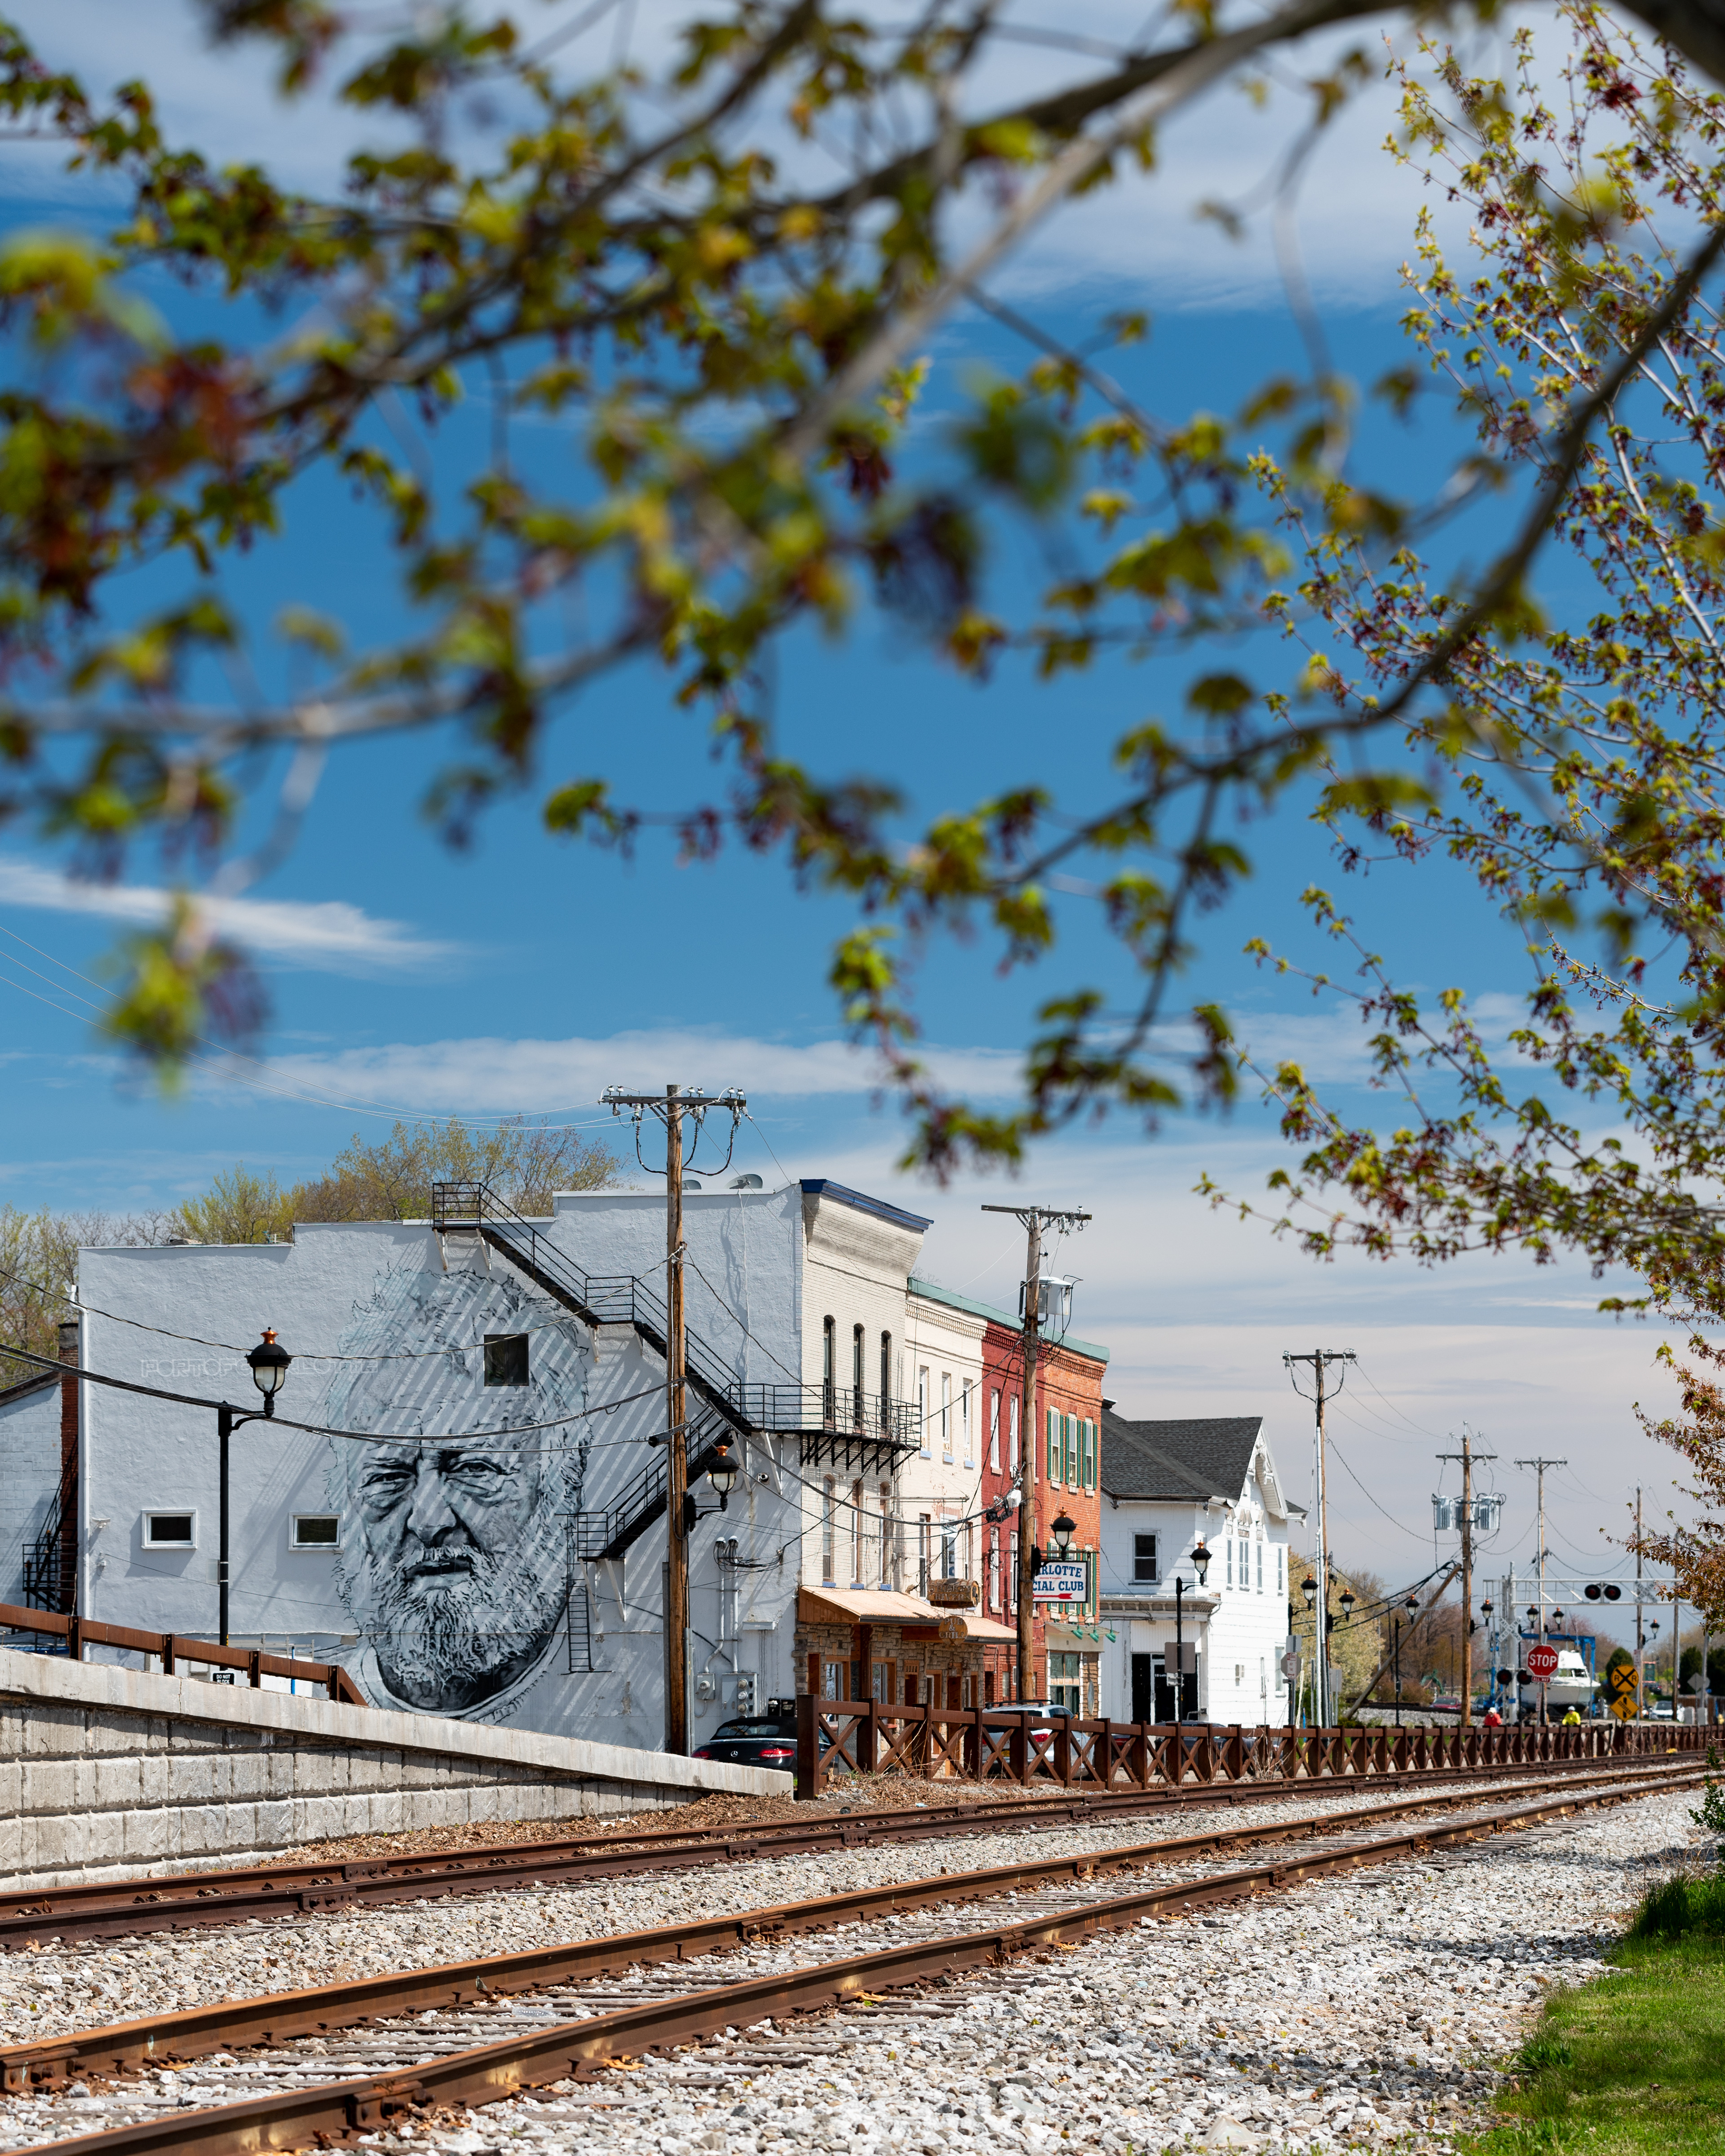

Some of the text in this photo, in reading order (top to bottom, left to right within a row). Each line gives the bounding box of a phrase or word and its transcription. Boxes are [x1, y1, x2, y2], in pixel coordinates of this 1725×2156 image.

[235, 1357, 378, 1377] CRLOTTE
[1038, 1564, 1082, 1577] RLOTTE
[1033, 1581, 1084, 1591] CIAL CLUB
[1529, 1654, 1557, 1667] STOP
